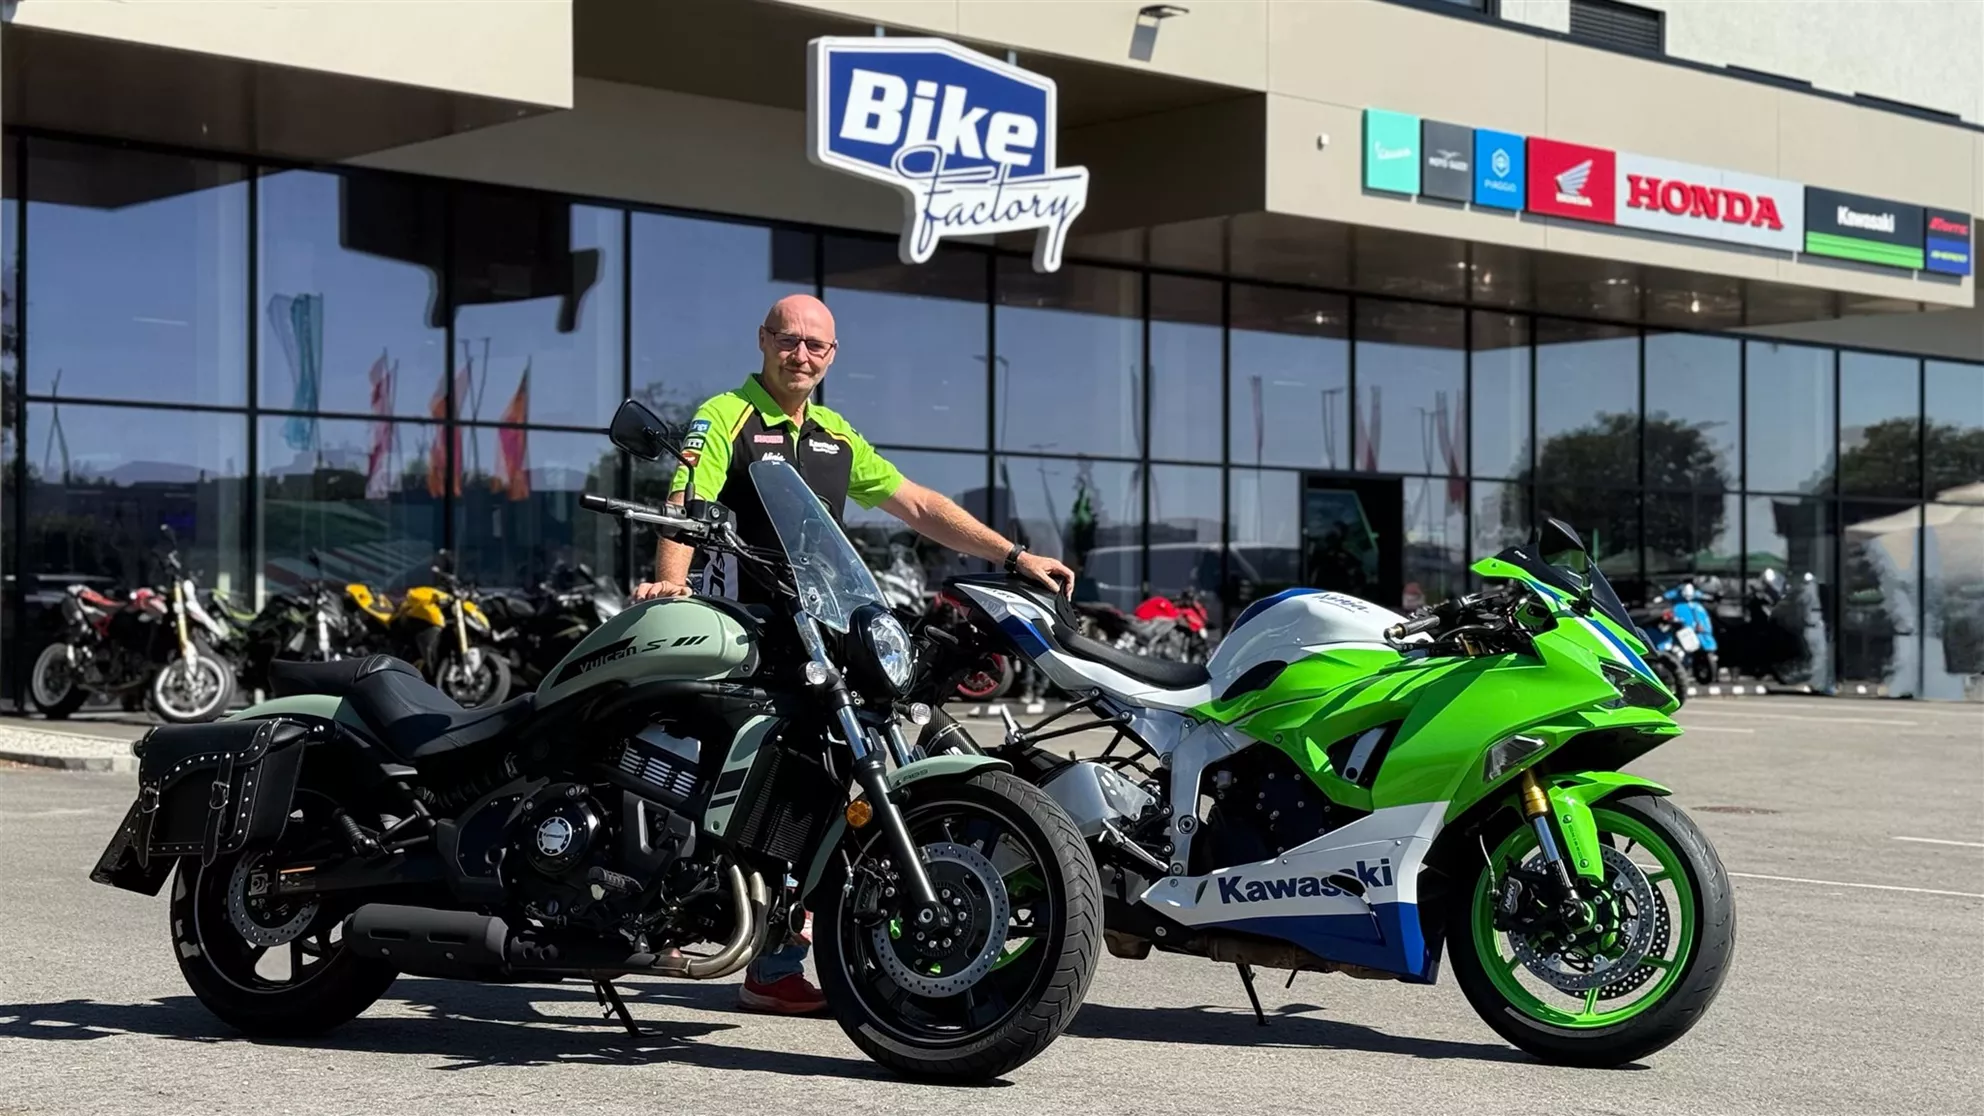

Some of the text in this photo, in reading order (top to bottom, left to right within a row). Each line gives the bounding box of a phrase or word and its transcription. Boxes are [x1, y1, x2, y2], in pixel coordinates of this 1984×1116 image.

[839, 68, 1038, 166] Bike
[1626, 174, 1785, 231] HONDA
[1837, 205, 1895, 233] Kawasaki
